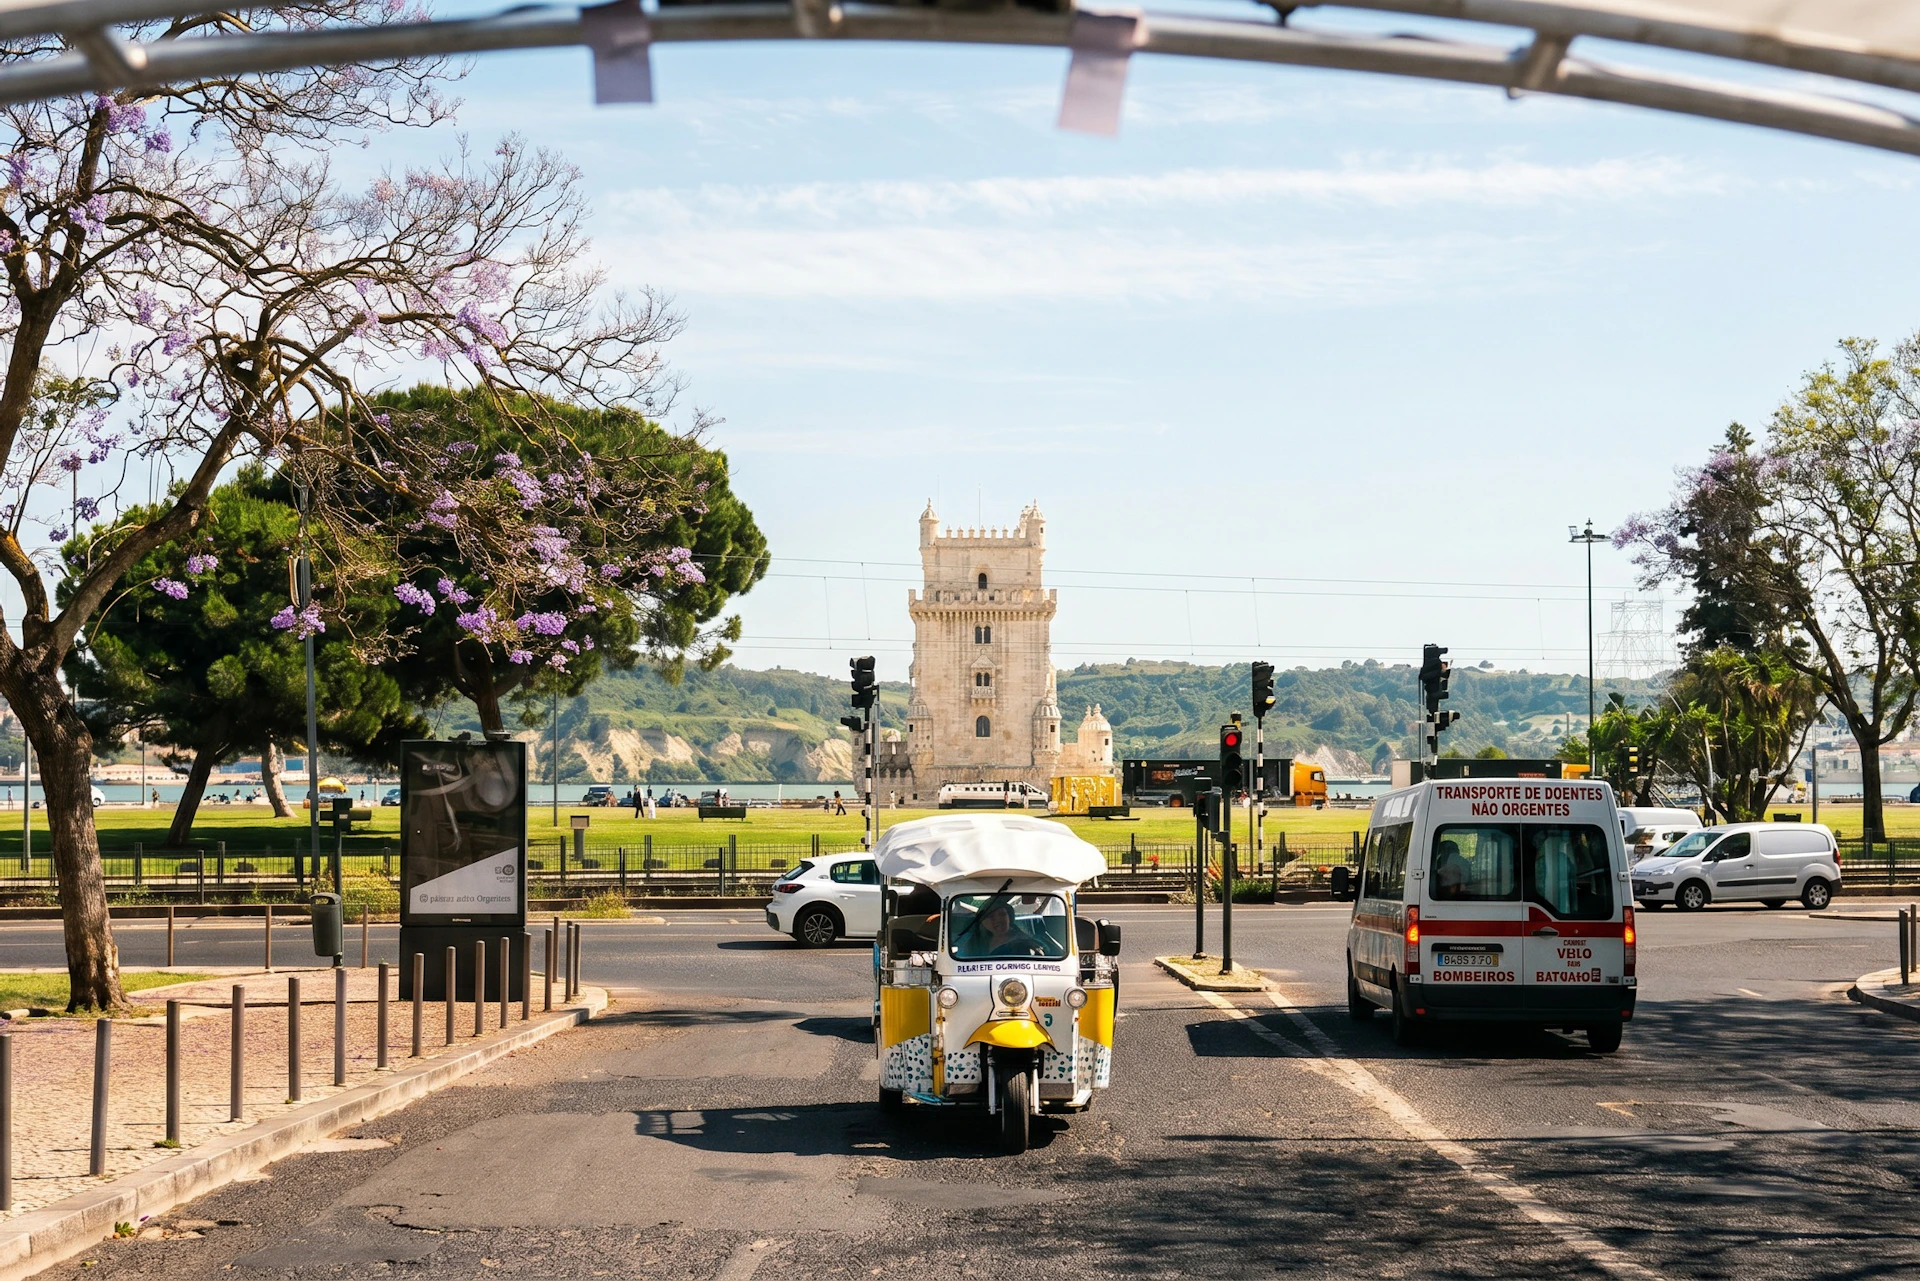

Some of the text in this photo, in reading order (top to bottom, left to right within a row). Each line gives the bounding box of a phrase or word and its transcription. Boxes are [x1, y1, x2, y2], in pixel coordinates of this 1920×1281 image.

[1437, 786, 1603, 801] TRANSPORTE DE DOENTES
[1502, 803, 1570, 816] ORGENTES
[1433, 970, 1515, 982] BOMBEIROS
